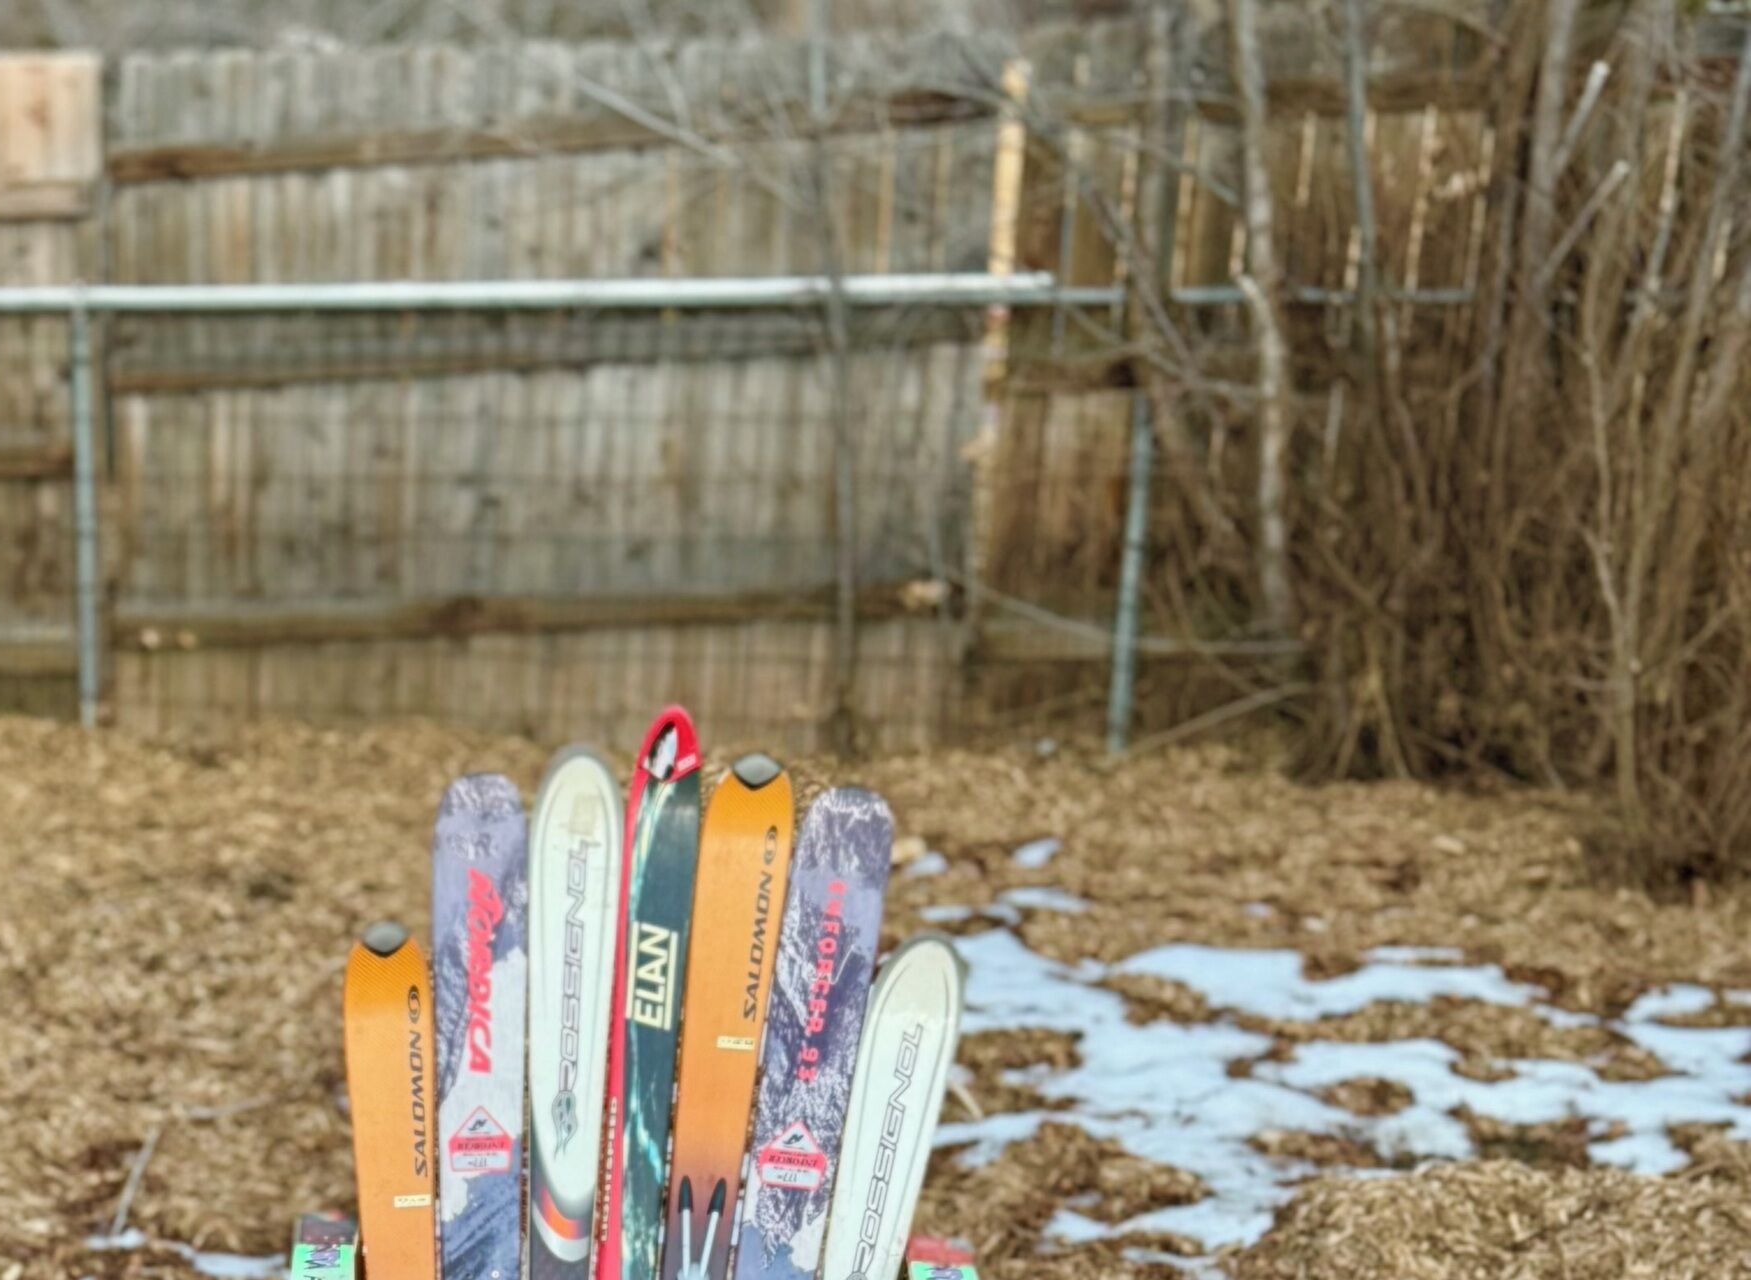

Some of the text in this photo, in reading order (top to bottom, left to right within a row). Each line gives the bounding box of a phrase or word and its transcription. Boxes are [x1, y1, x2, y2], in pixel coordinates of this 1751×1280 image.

[467, 867, 504, 1074] NORDICA
[558, 839, 601, 1092] ROSSIGNOL
[633, 922, 670, 1030] ELAN
[743, 871, 773, 1023] SALOMON
[807, 880, 848, 1034] ENFORCER
[409, 1030, 428, 1178] SALOMON
[852, 1023, 924, 1274] ROSSIGNOL
